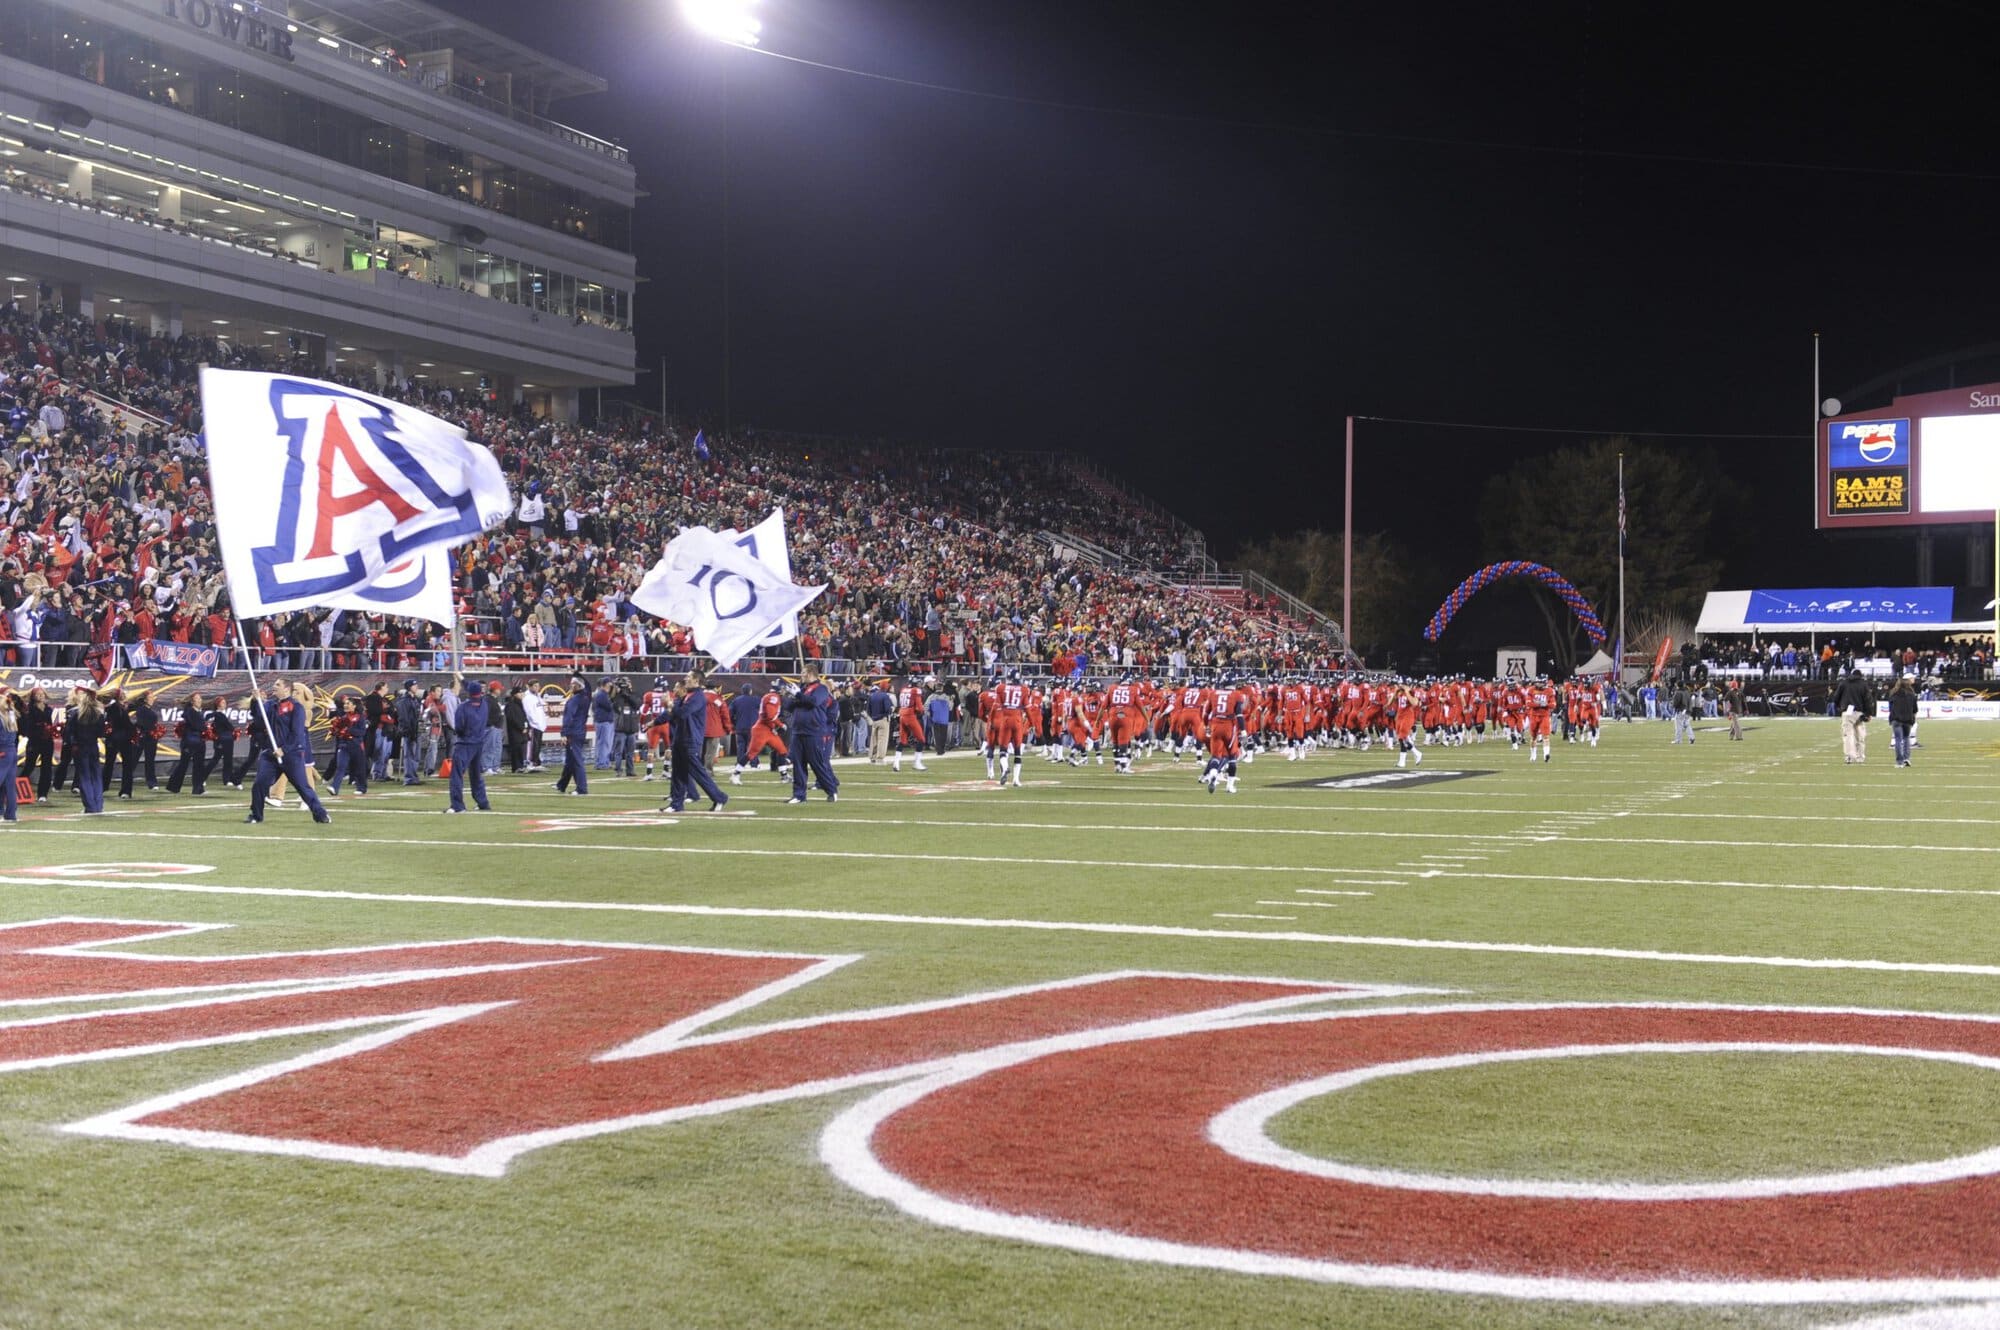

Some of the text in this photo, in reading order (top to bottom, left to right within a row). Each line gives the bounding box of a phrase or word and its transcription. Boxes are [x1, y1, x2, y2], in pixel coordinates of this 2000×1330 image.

[1836, 475, 1903, 491] SAM'S
[1836, 490, 1901, 503] TOWN
[19, 673, 95, 688] Pioneer
[1216, 694, 1228, 713] 5
